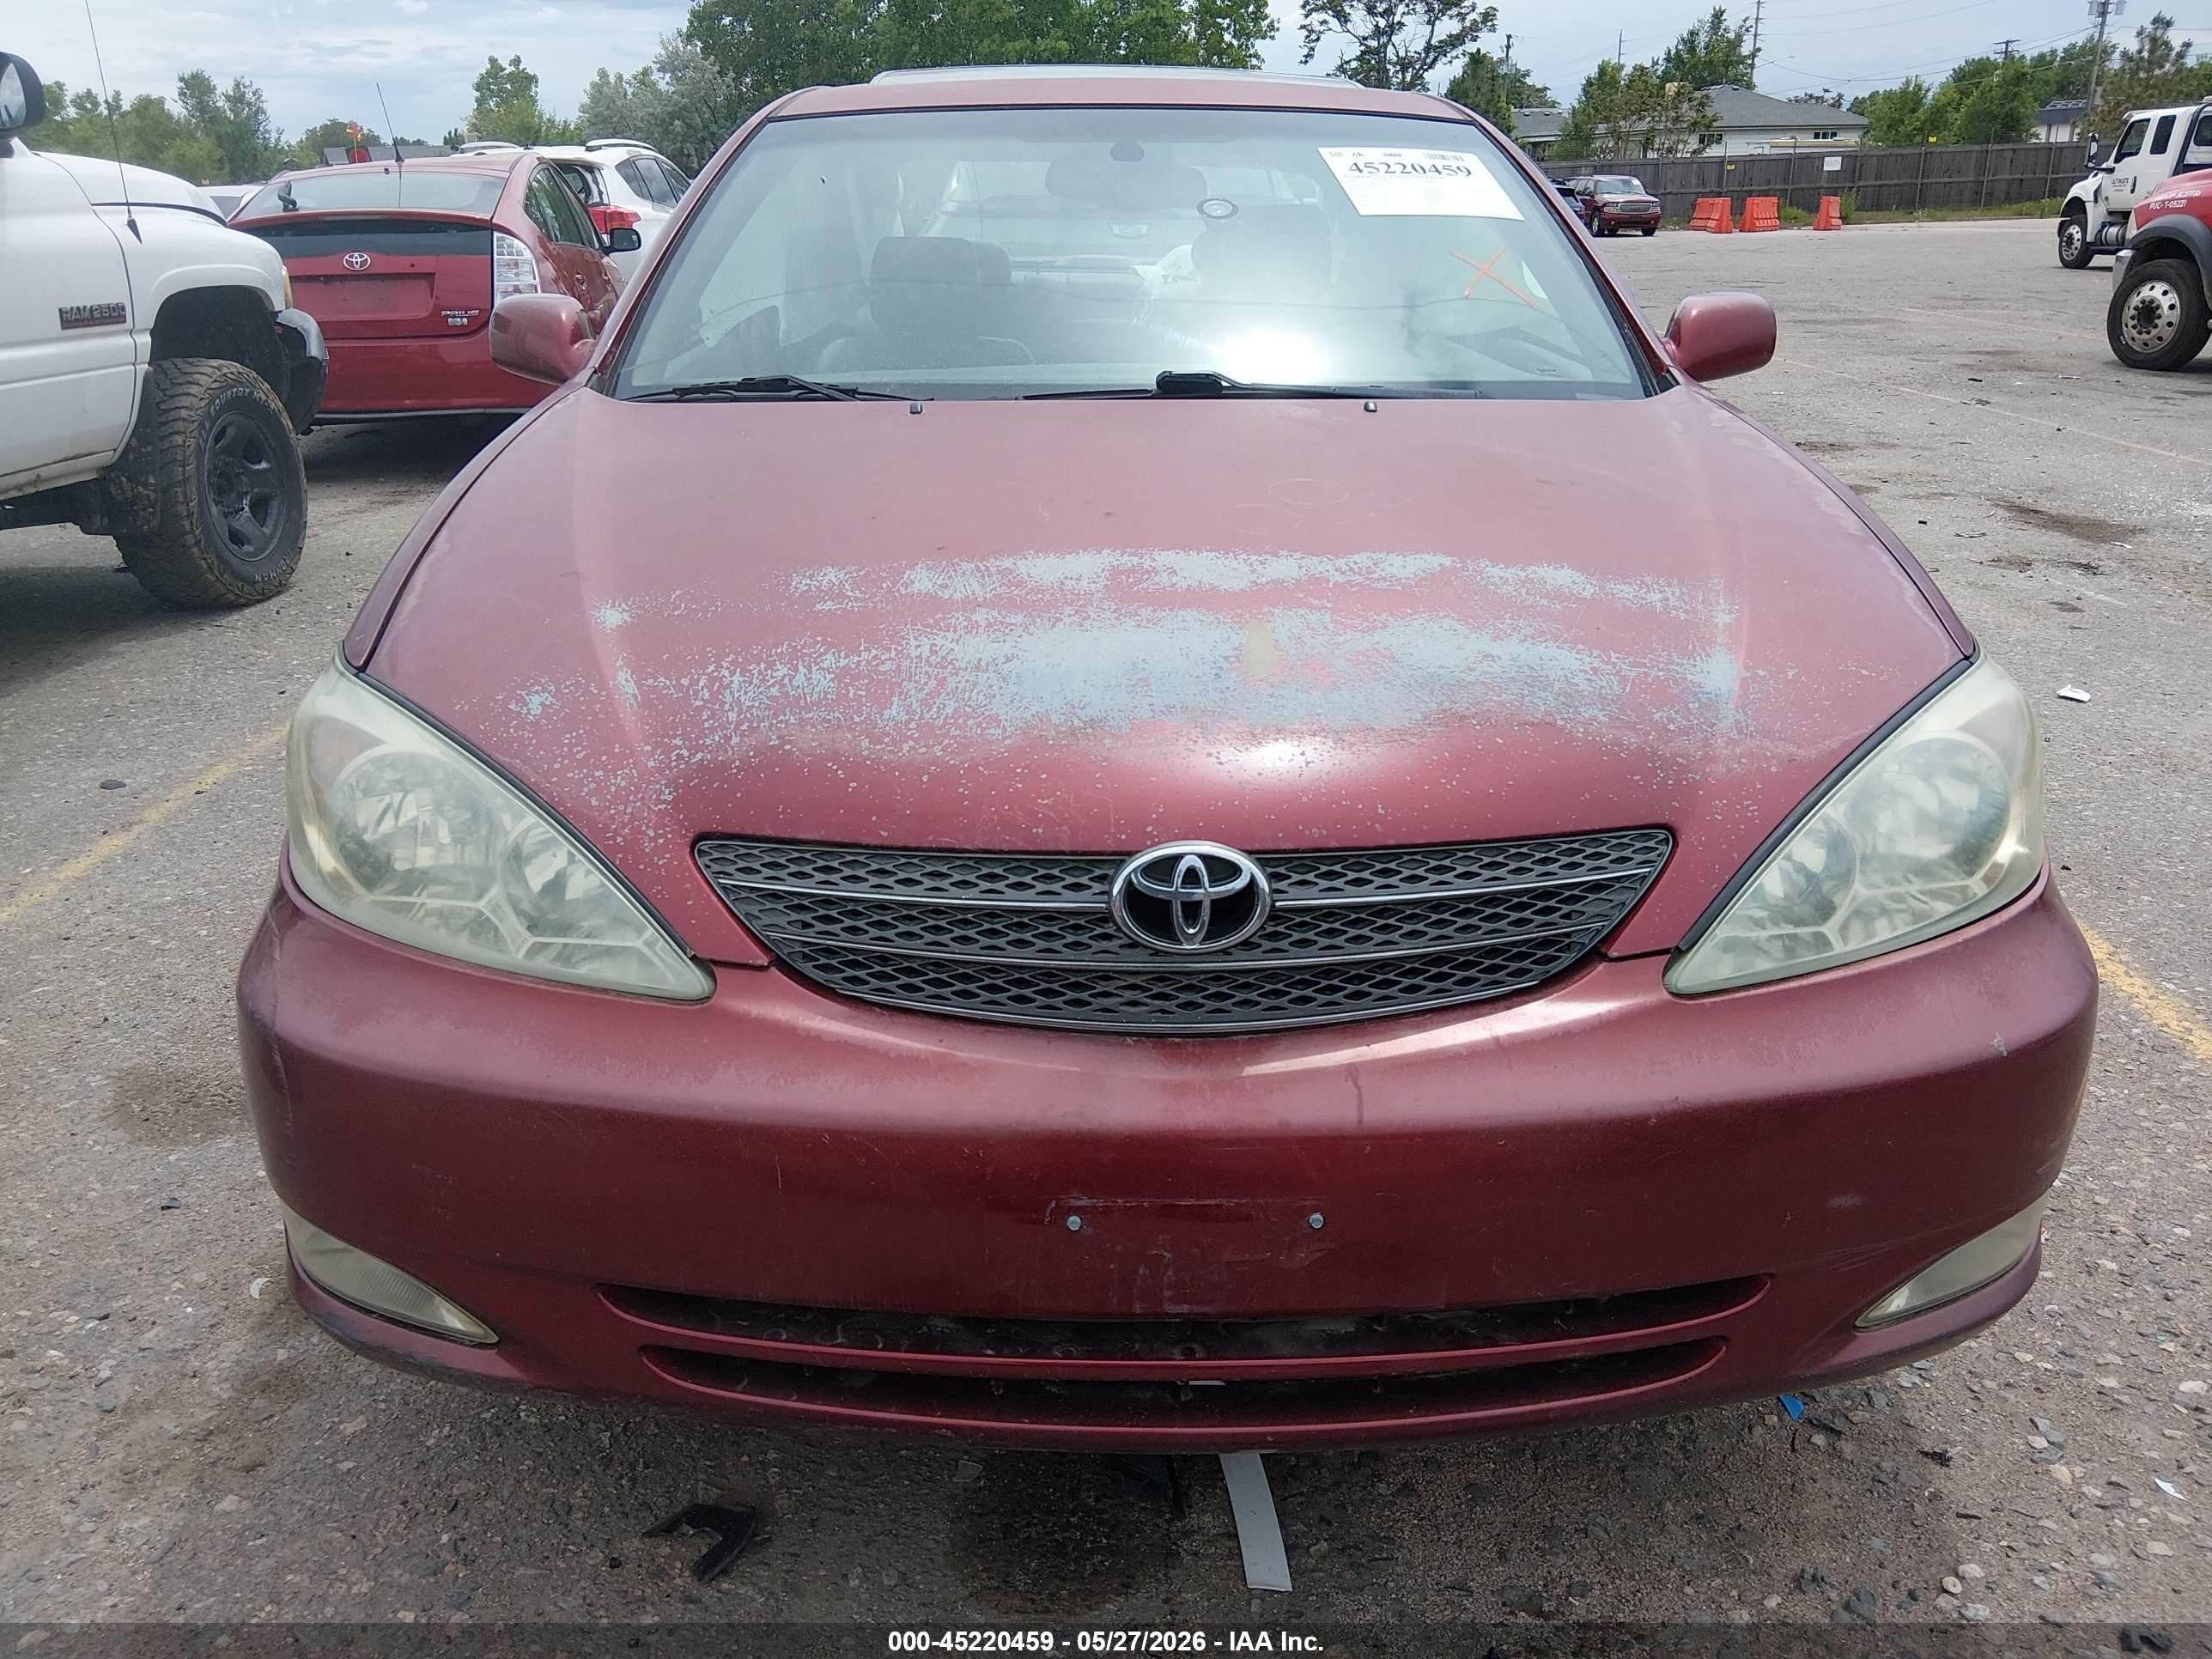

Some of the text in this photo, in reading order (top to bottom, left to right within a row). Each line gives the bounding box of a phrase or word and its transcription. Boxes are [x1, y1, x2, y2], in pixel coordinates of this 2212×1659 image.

[1349, 162, 1472, 177] 45220459
[60, 302, 126, 322] RAM 2500
[210, 387, 250, 417] COUNTRY
